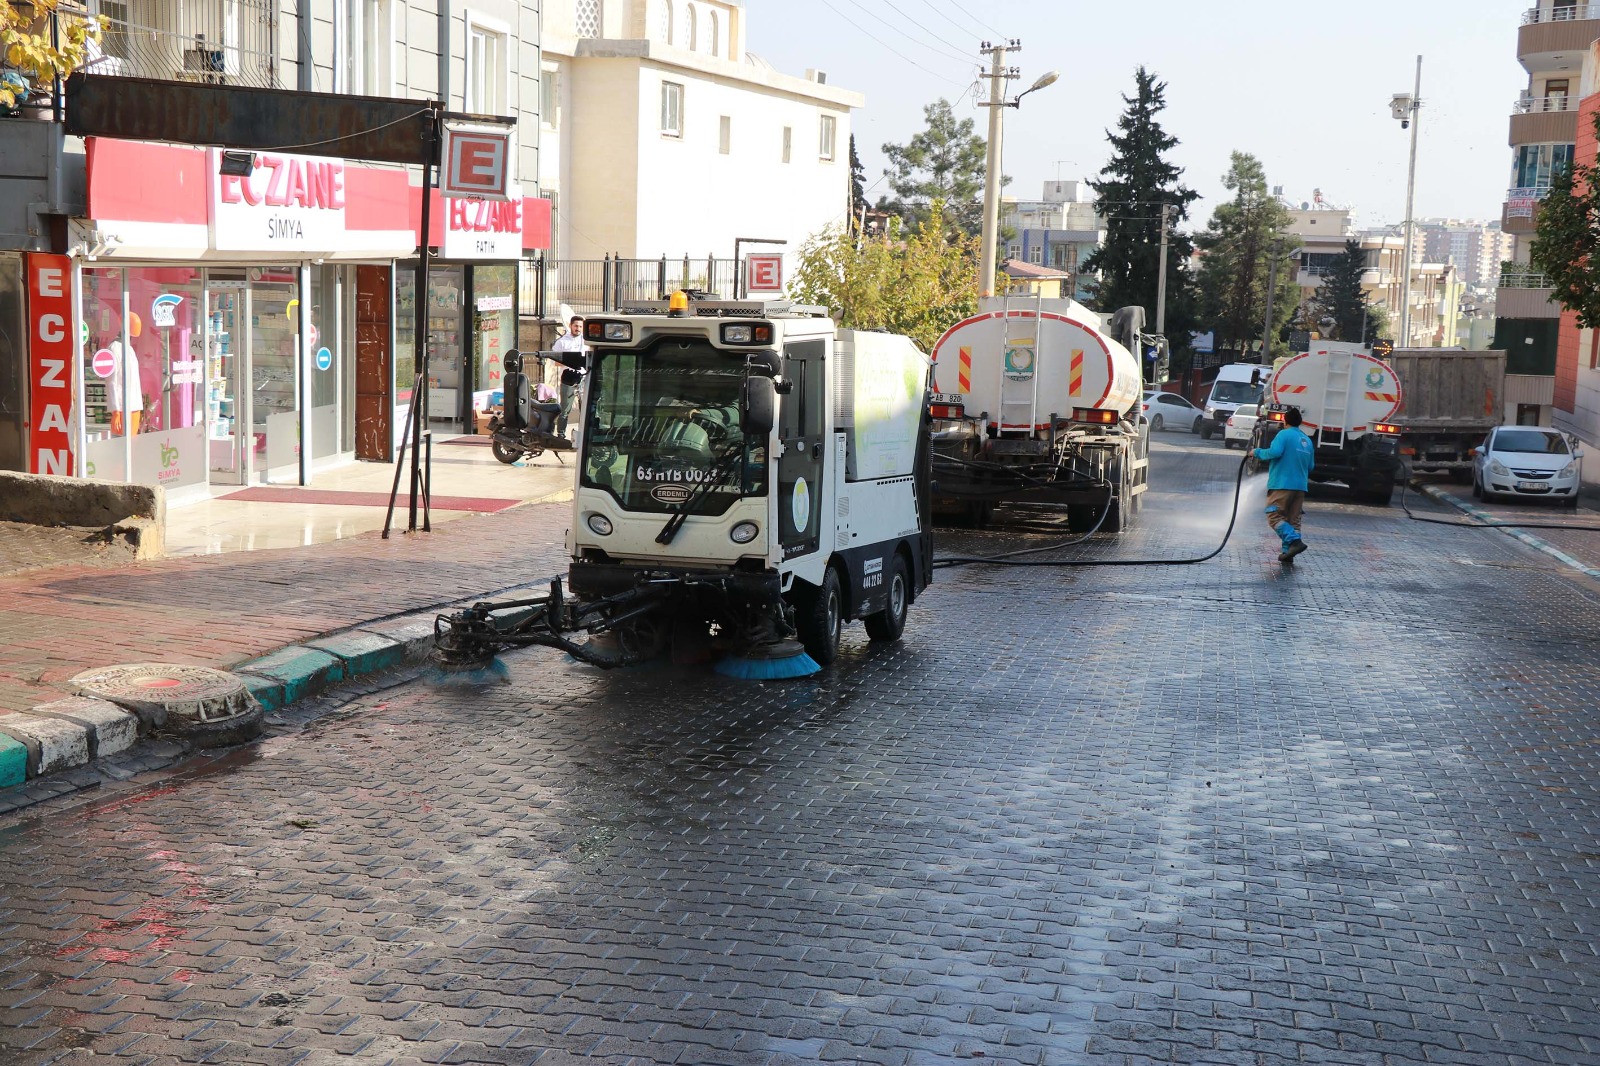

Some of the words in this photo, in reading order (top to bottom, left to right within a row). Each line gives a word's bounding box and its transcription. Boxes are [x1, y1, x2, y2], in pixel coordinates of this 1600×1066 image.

[459, 141, 495, 186] E
[220, 151, 345, 210] ECZANE
[268, 213, 304, 239] SİMYA
[450, 197, 521, 234] ECZANE
[756, 263, 774, 285] E
[191, 340, 213, 351] AÇK
[637, 465, 652, 481] 63
